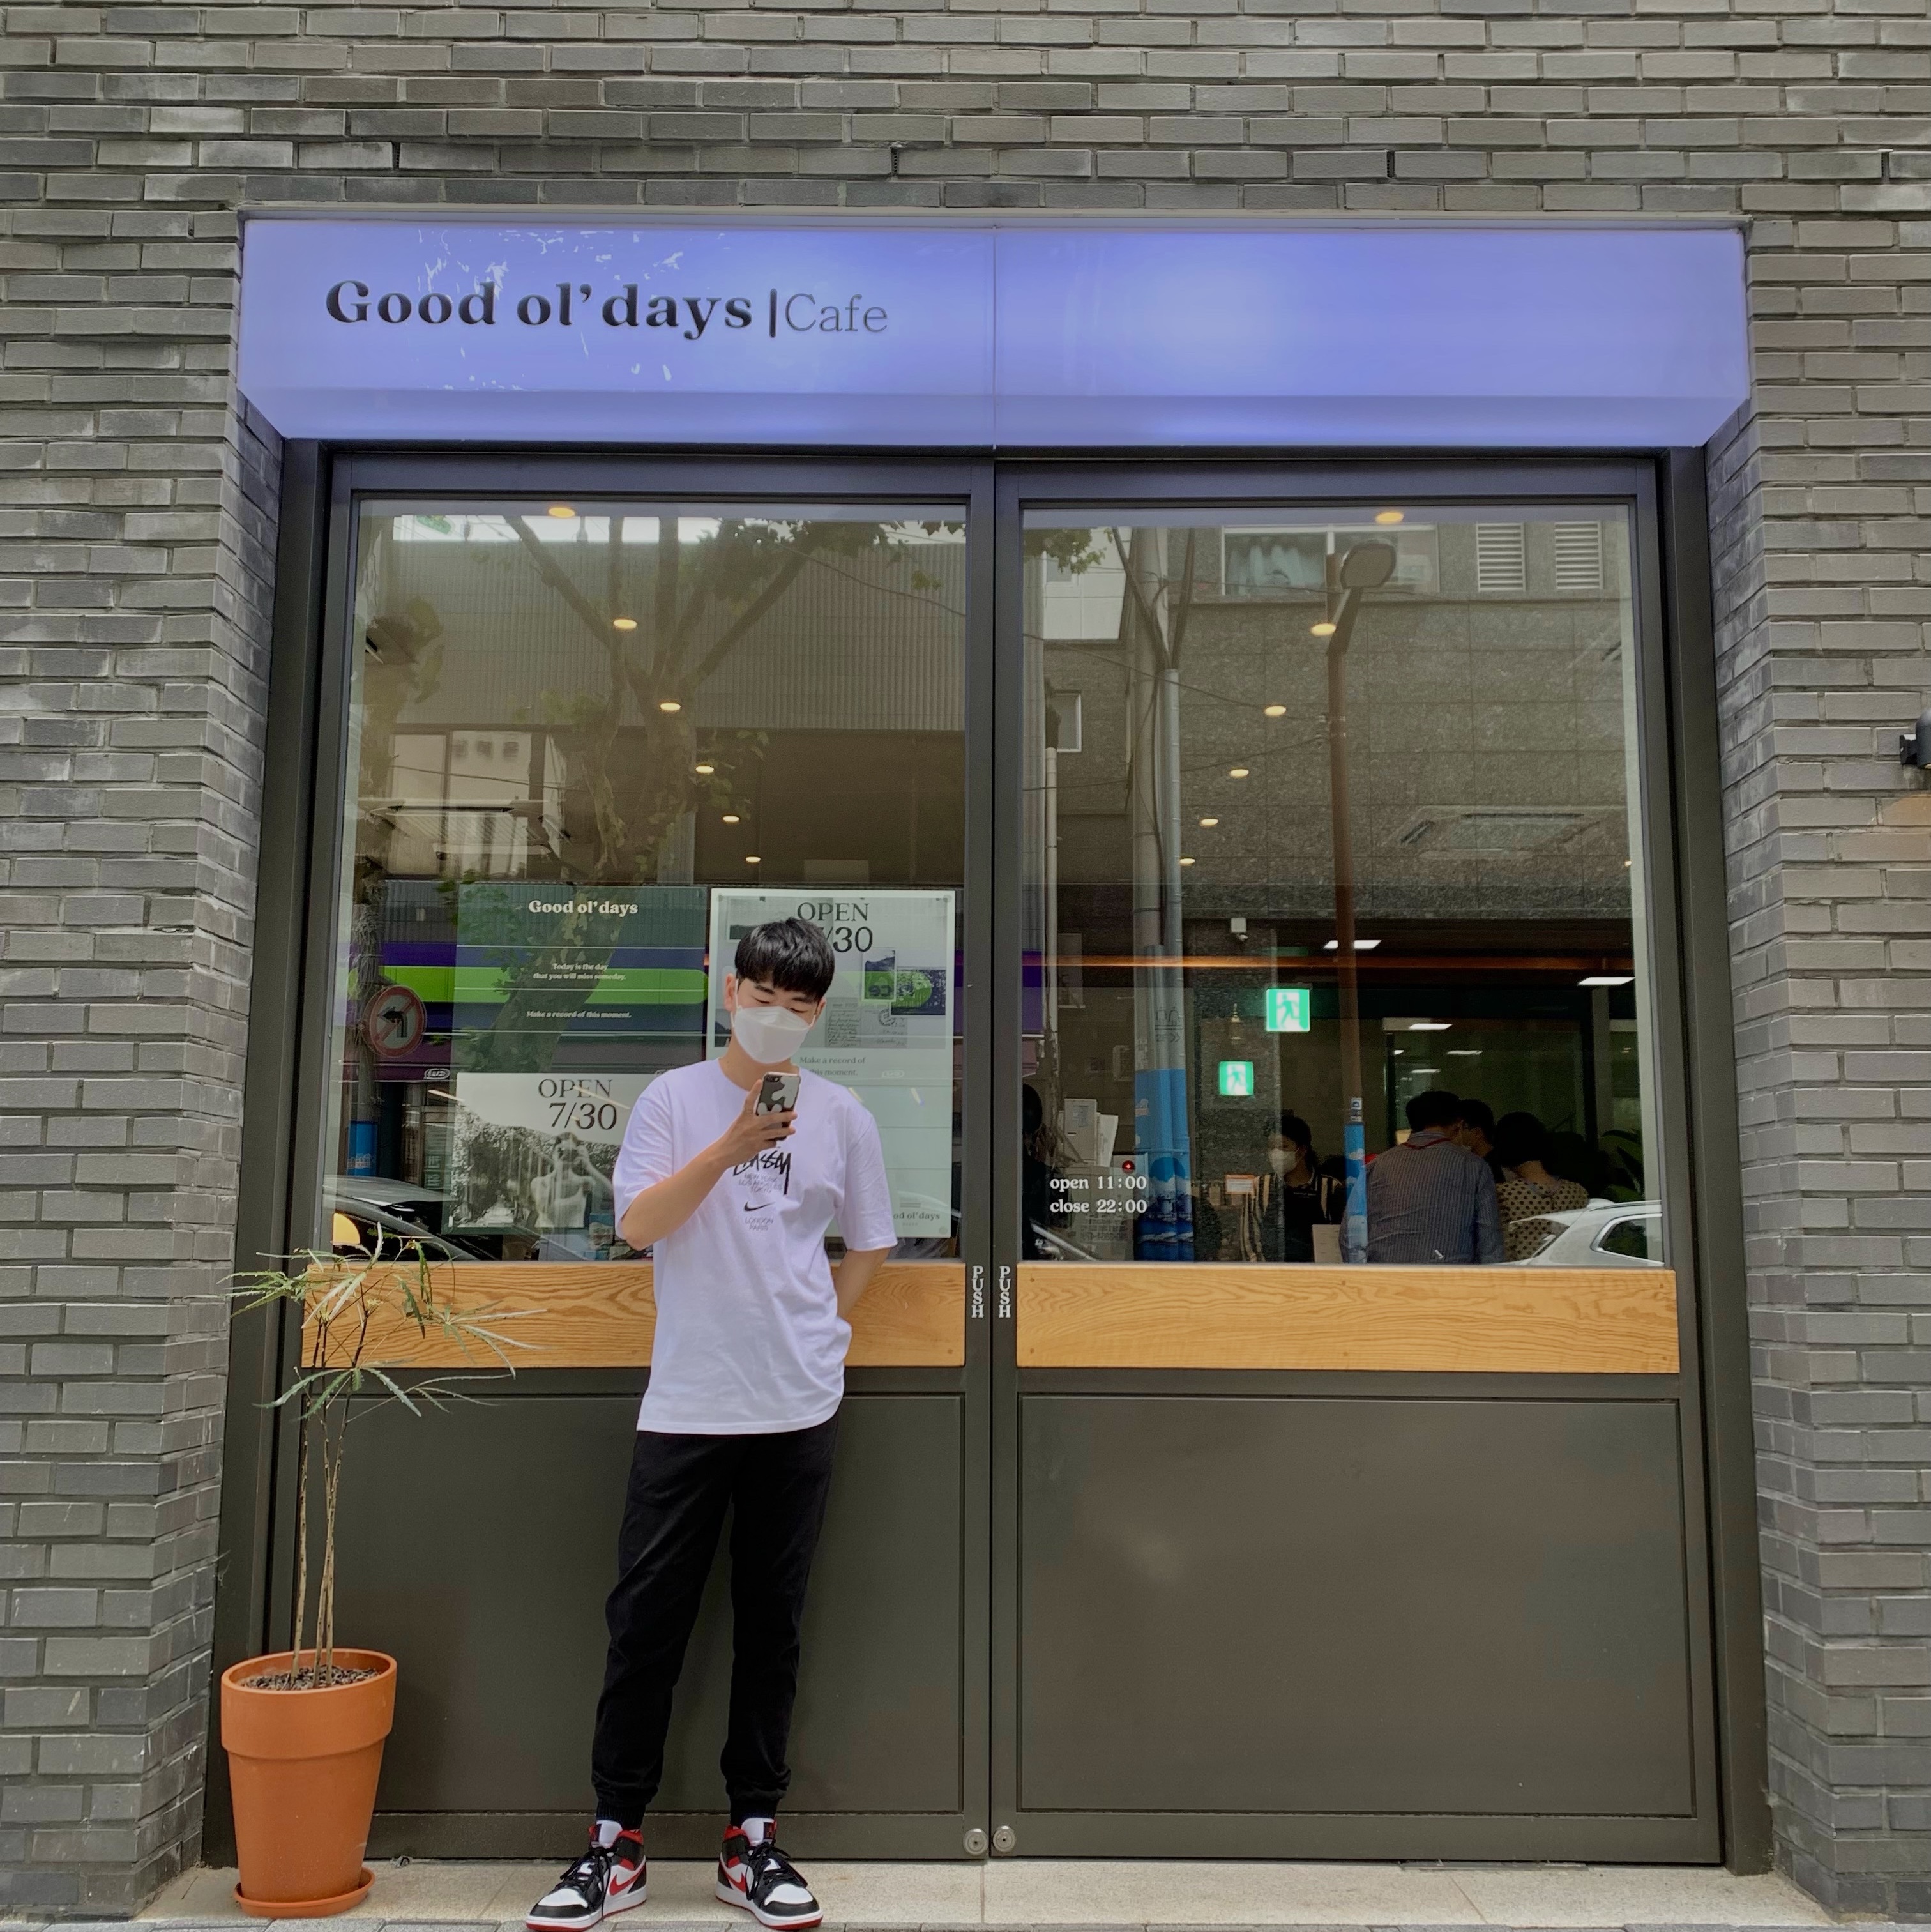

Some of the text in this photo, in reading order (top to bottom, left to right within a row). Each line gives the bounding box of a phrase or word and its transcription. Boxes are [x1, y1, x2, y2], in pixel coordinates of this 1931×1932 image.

[326, 280, 496, 324] Good
[785, 293, 888, 333] Cafe
[528, 900, 574, 913] Good
[797, 902, 870, 921] OPEN
[818, 926, 873, 952] /30
[538, 1079, 612, 1098] OPEN
[549, 1102, 617, 1130] 7/30
[1050, 1176, 1147, 1192] open 11:00
[1050, 1198, 1147, 1213] close 22:00
[971, 1265, 984, 1318] PUSH
[998, 1265, 1011, 1318] PUSH
